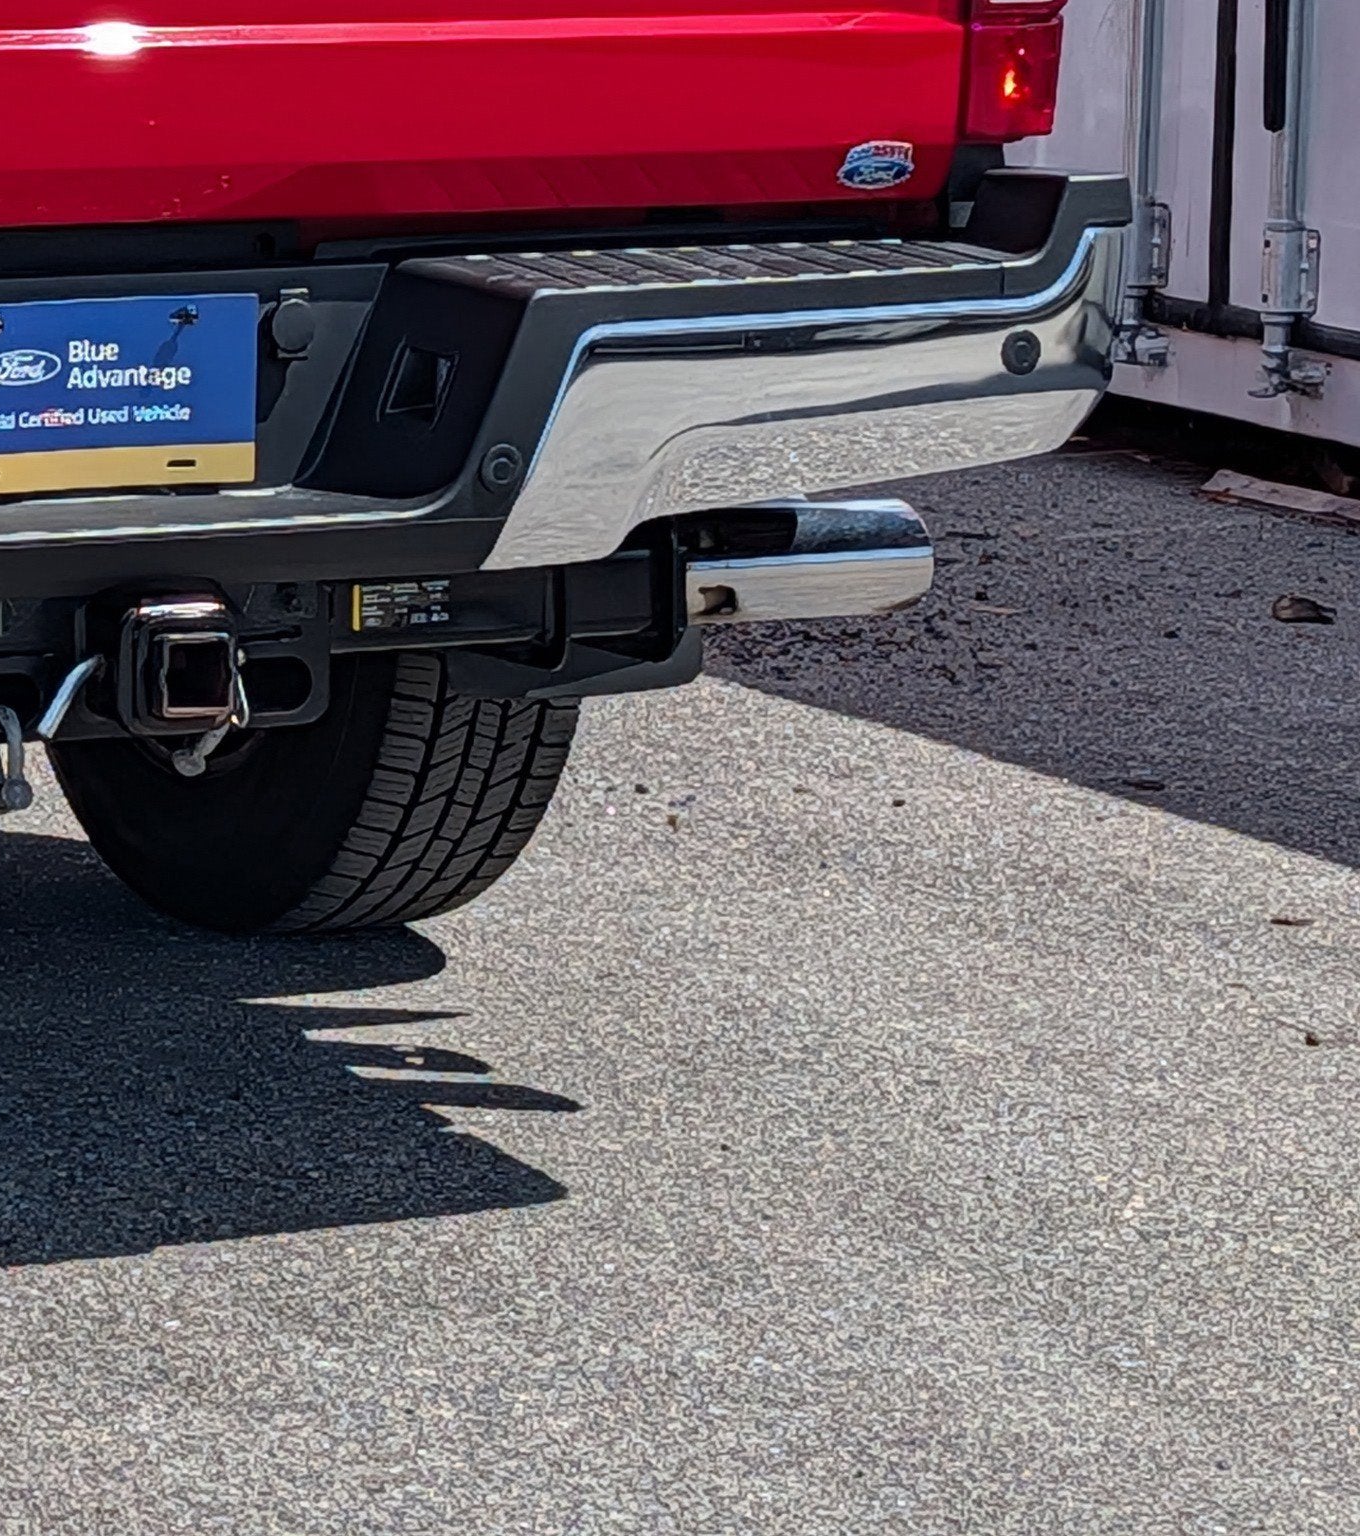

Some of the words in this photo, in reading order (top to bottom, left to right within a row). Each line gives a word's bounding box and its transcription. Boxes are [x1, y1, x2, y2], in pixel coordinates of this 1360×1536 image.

[68, 339, 120, 363] Blue
[67, 365, 192, 391] Advantage
[19, 408, 84, 429] Certified
[88, 406, 129, 424] Used
[133, 403, 191, 423] Vehicle
